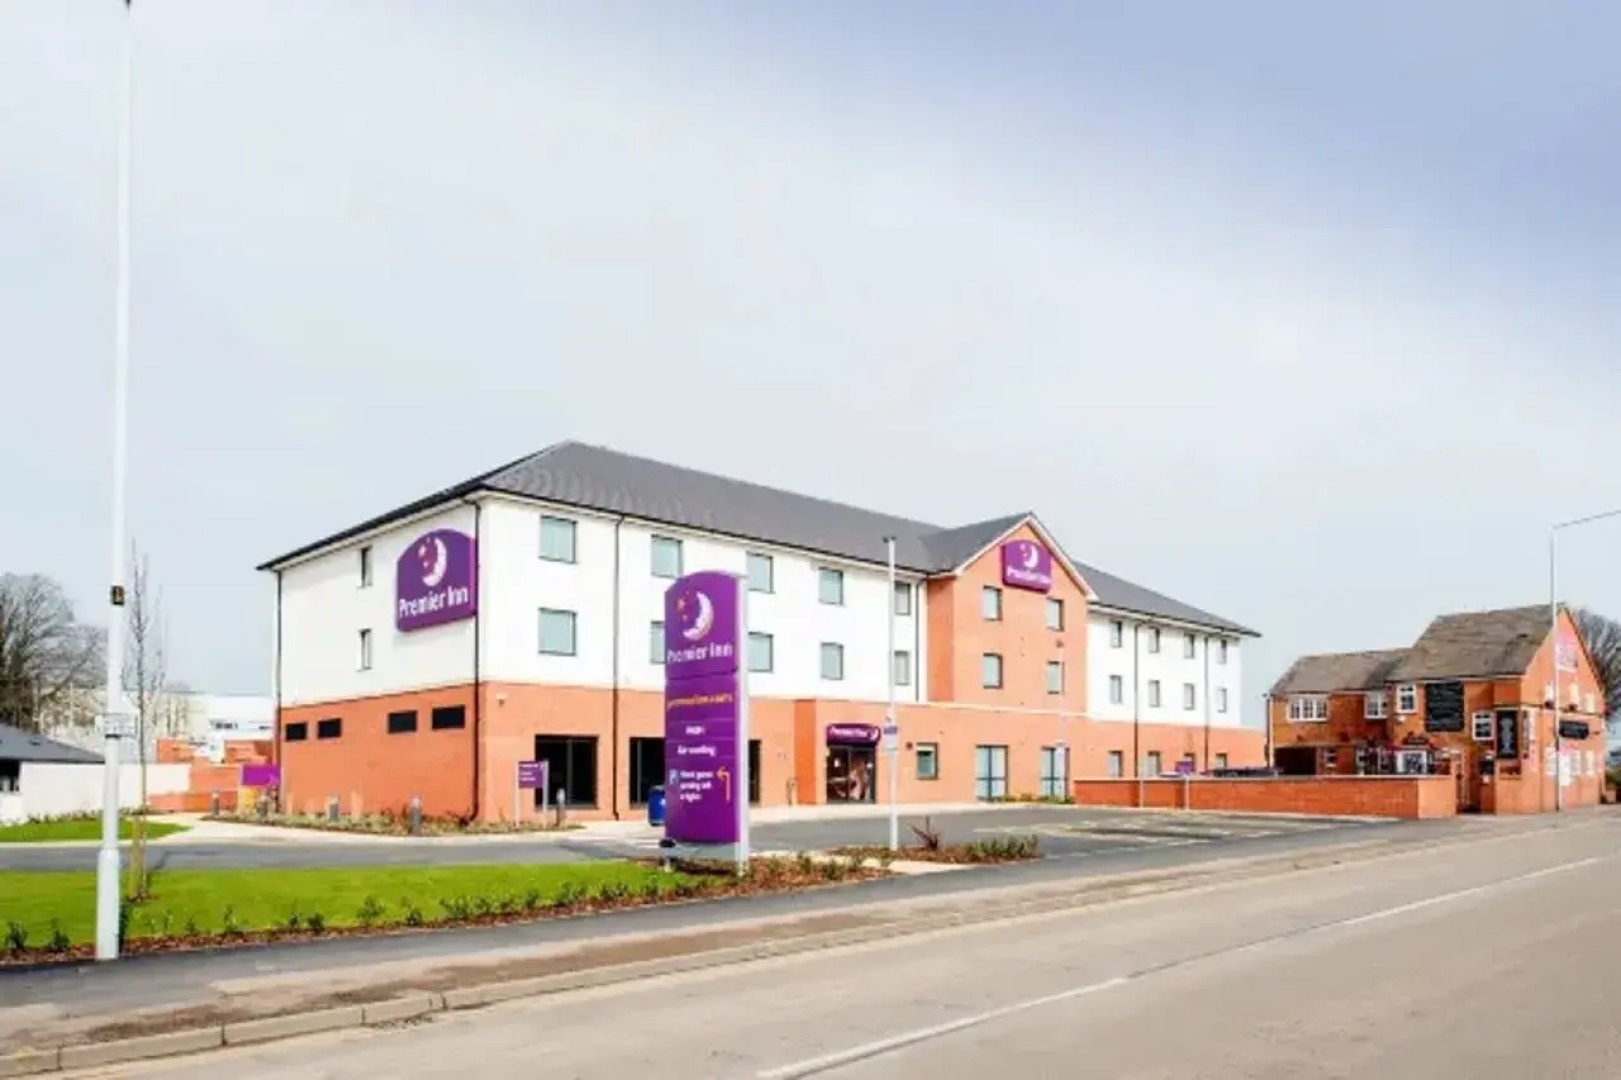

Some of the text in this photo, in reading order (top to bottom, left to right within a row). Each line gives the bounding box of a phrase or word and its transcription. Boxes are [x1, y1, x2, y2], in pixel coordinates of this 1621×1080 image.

[399, 585, 469, 618] Premier Inn
[666, 641, 733, 665] Premier Inn
